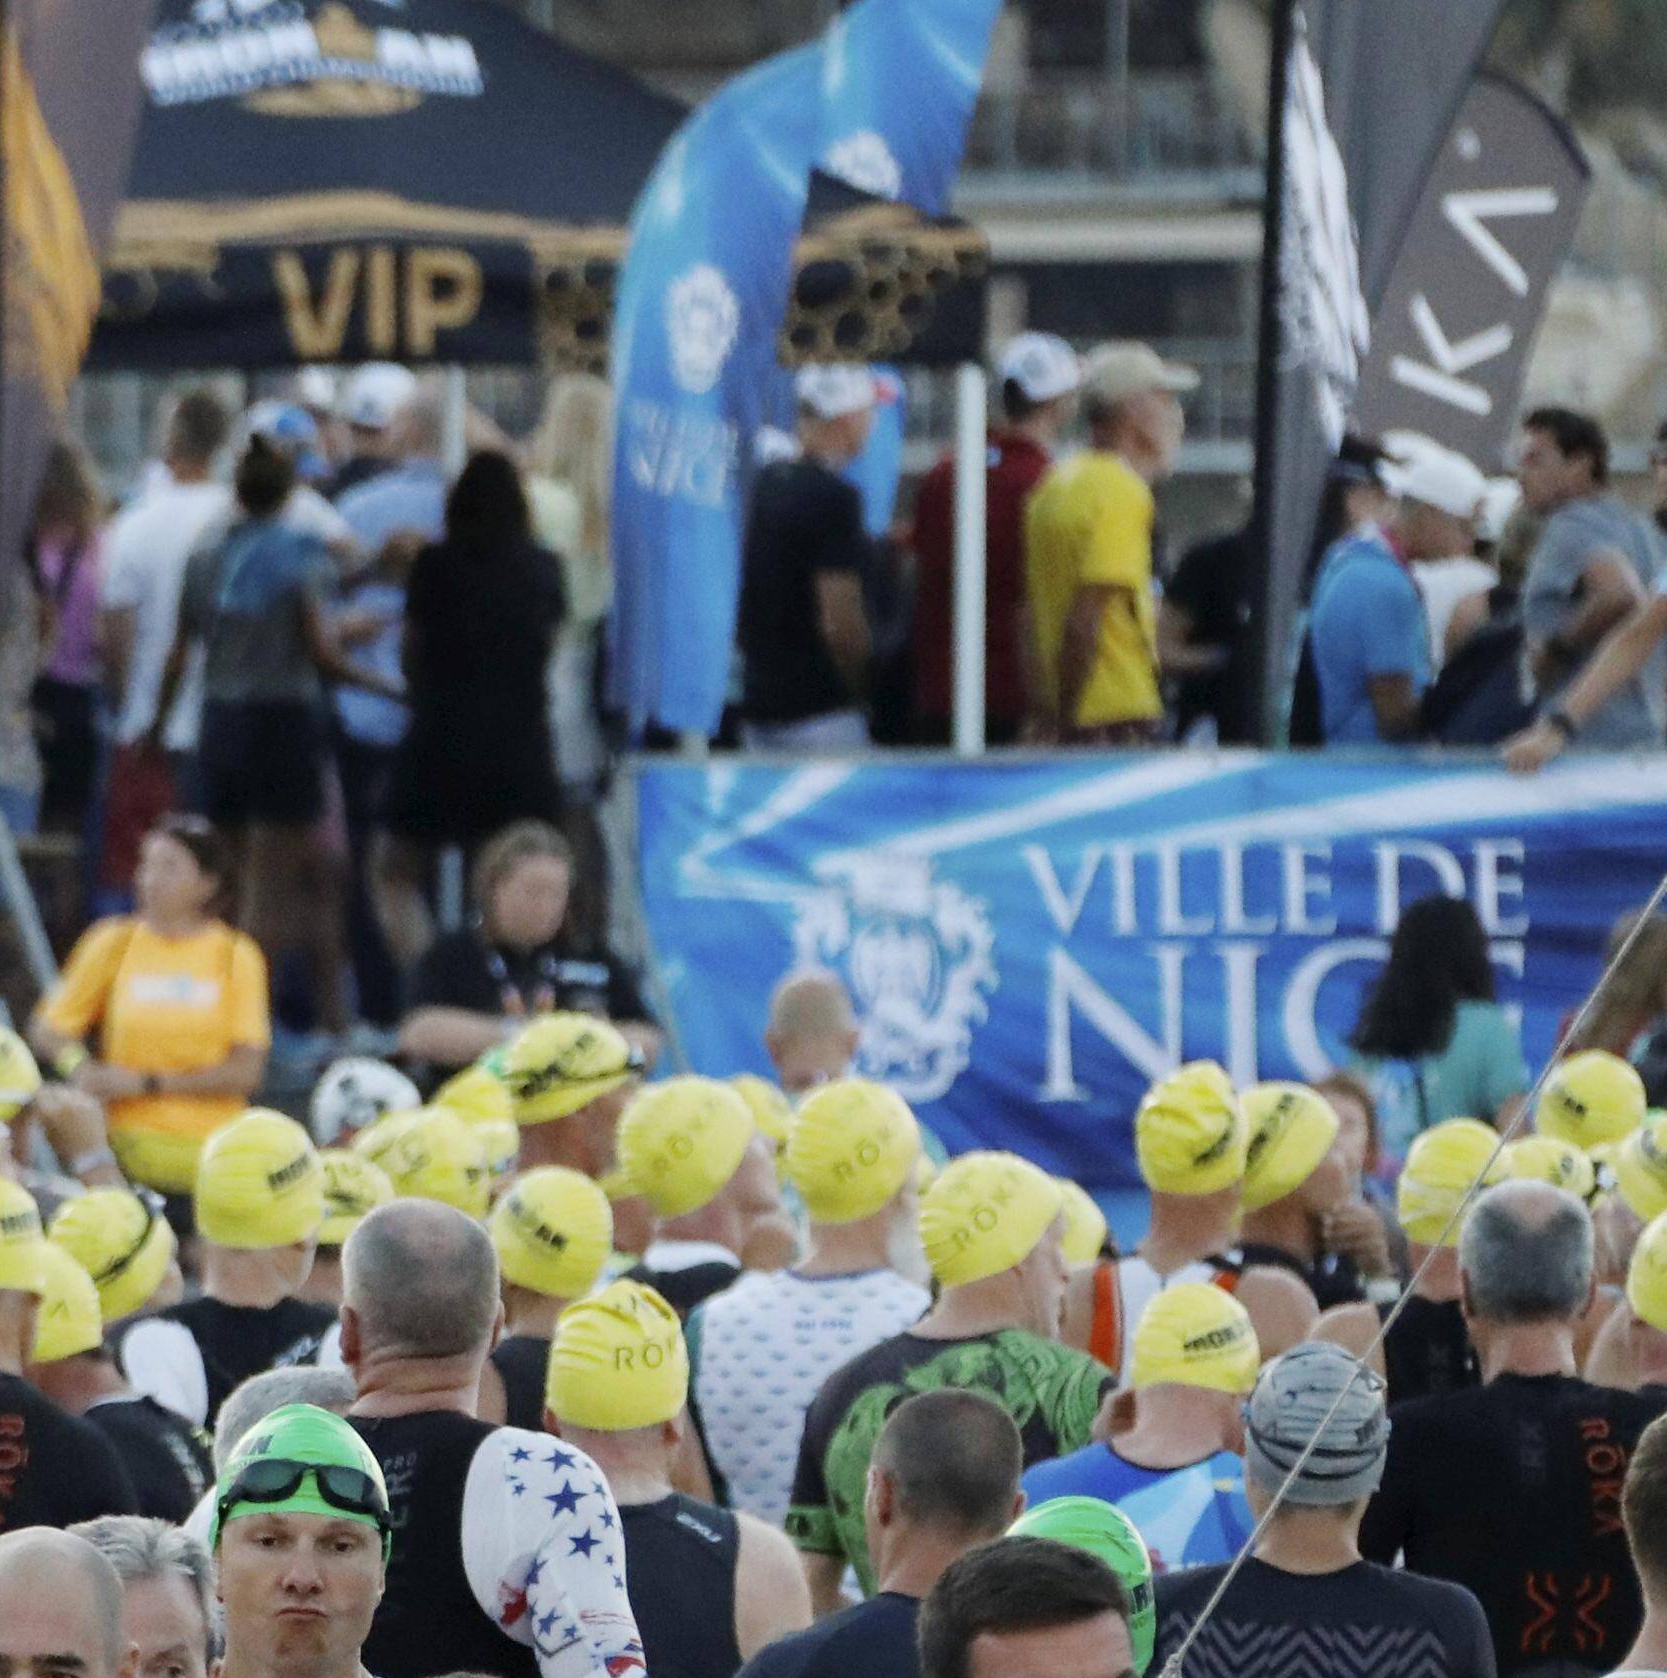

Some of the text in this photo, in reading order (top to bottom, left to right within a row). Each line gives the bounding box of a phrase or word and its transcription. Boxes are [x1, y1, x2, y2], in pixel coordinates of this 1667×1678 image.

[273, 245, 484, 359] VIP
[1022, 838, 1530, 937] VILLE DE
[1037, 936, 1527, 1102] NIC
